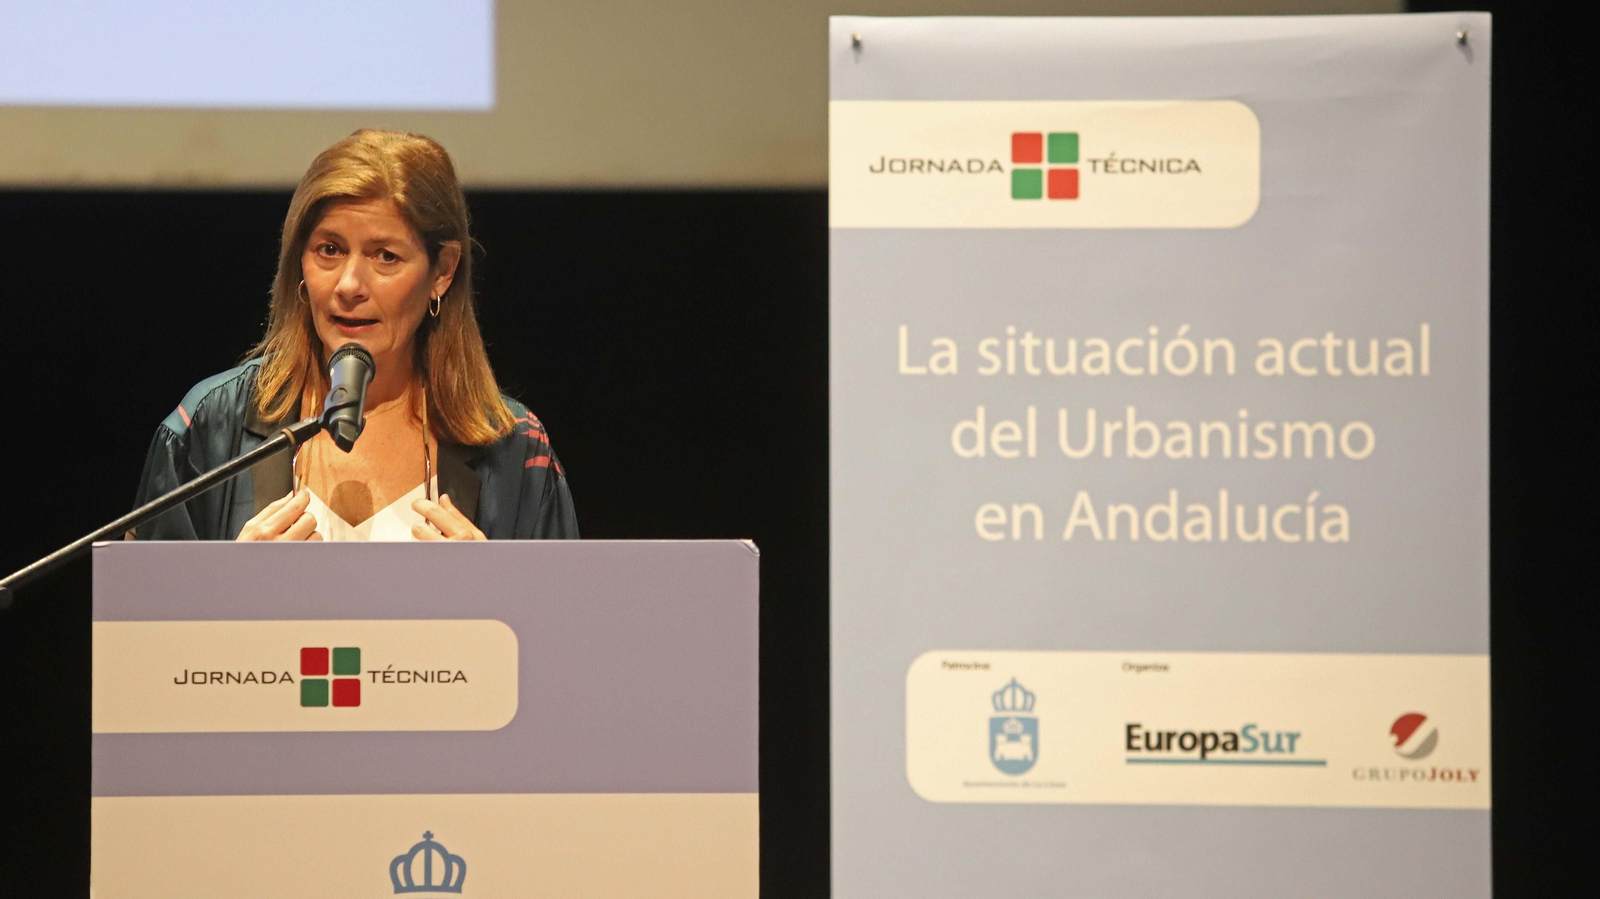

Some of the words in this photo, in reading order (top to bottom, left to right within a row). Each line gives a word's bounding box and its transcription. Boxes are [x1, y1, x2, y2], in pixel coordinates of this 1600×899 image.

[869, 155, 1005, 174] JORNADA
[1087, 151, 1202, 175] TÉCNICA
[898, 325, 958, 375] La
[977, 324, 1236, 376] situación
[1254, 322, 1431, 377] actual
[951, 405, 1037, 458] del
[1058, 406, 1376, 460] Urbanismo
[974, 501, 1044, 541] en
[1062, 488, 1350, 543] Andalucía
[173, 669, 295, 686] JORNADA
[366, 664, 468, 685] TÉCNICA
[1125, 723, 1301, 759] EuropaSur
